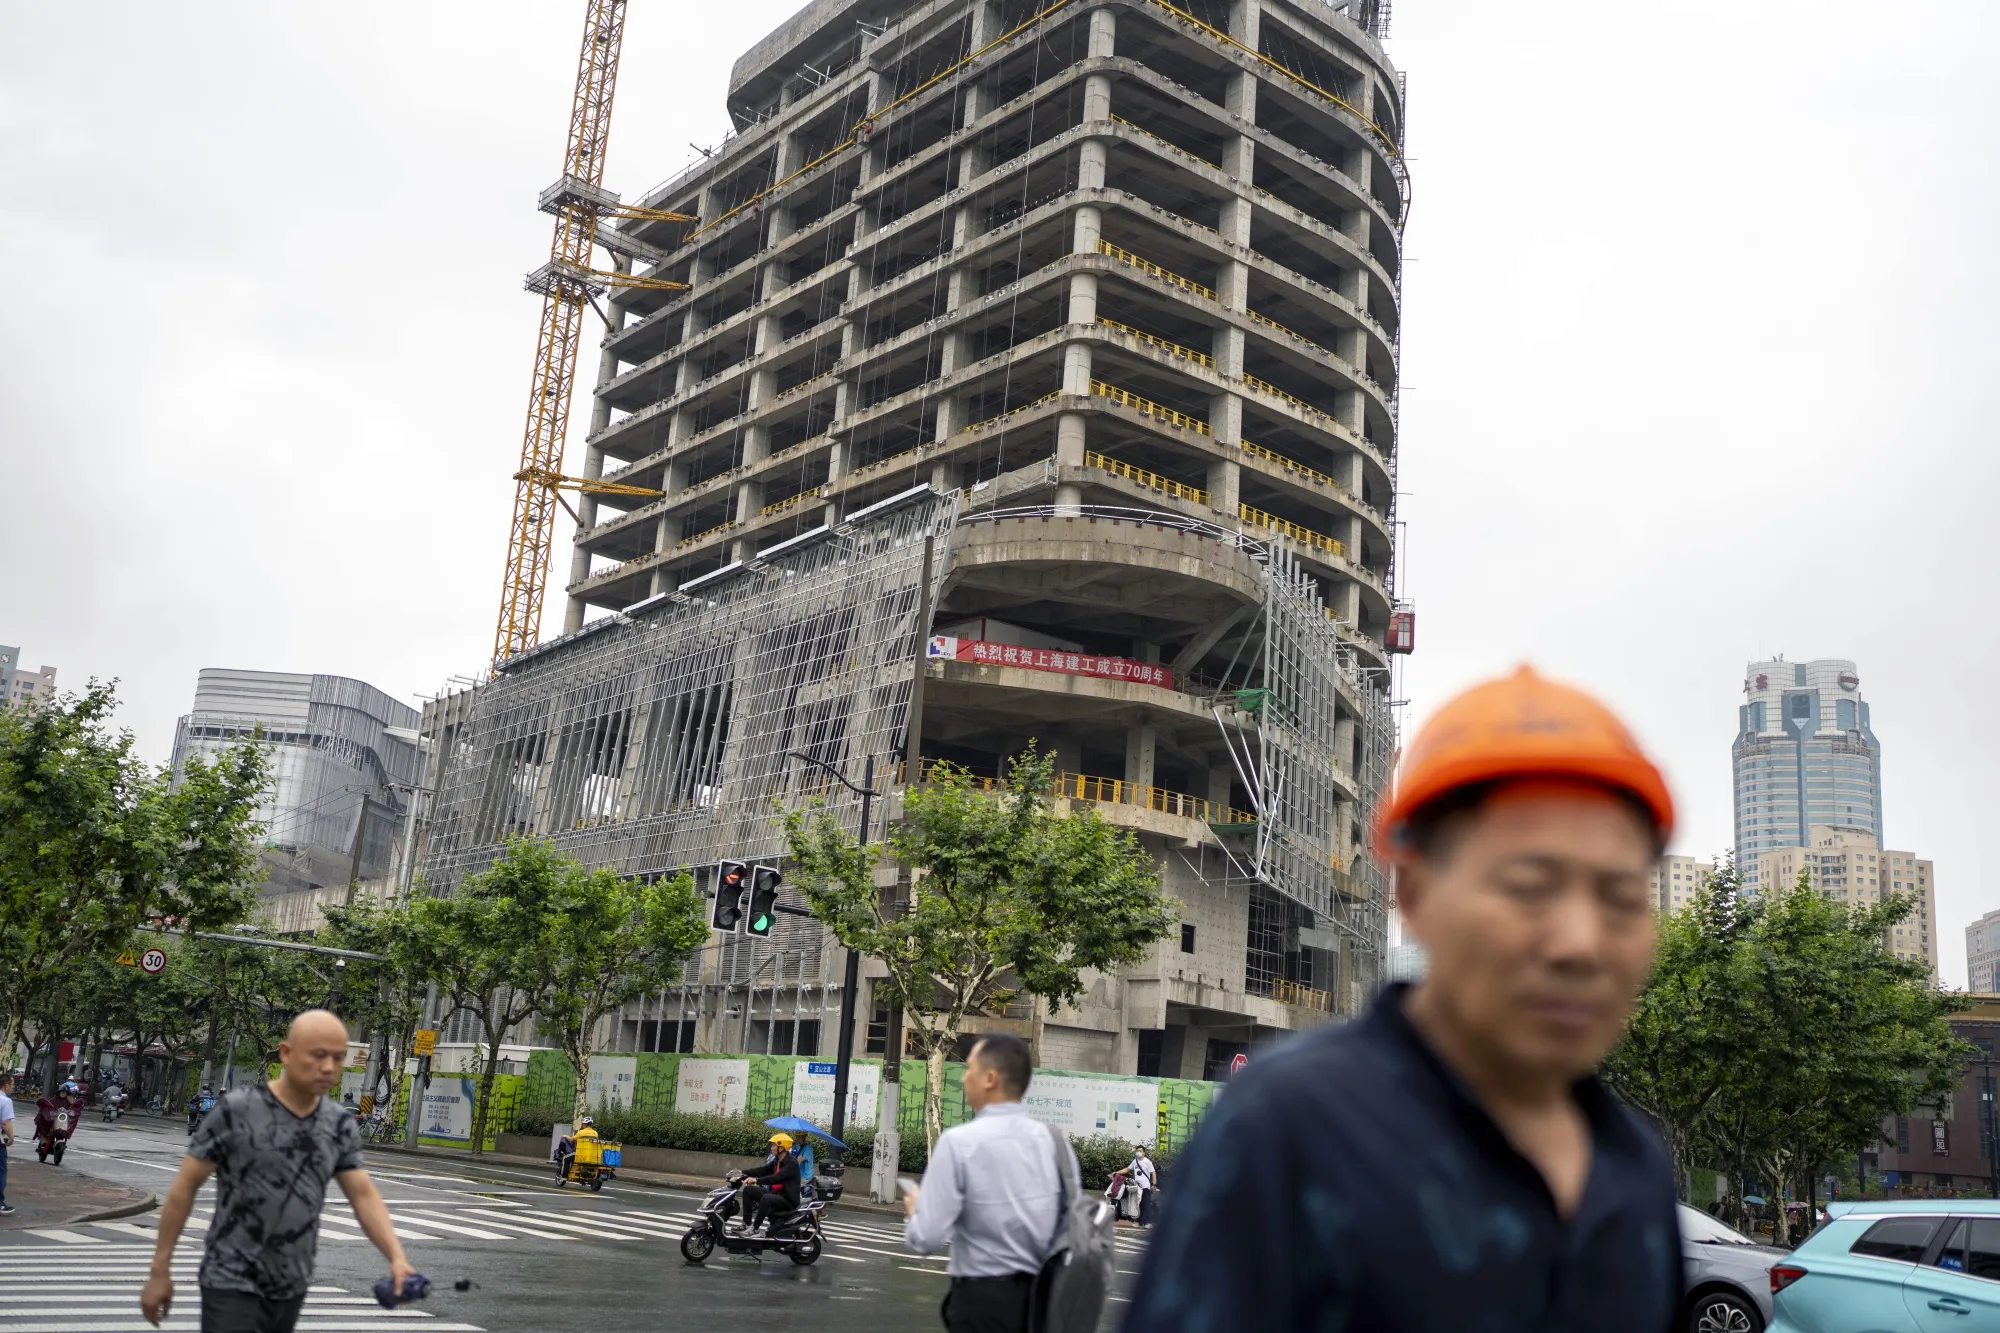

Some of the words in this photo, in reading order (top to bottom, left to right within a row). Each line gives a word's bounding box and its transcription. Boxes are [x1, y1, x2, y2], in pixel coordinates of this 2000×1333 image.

[973, 643, 1163, 683] 热烈祝贺上海建工成立70周年
[146, 955, 162, 967] 30
